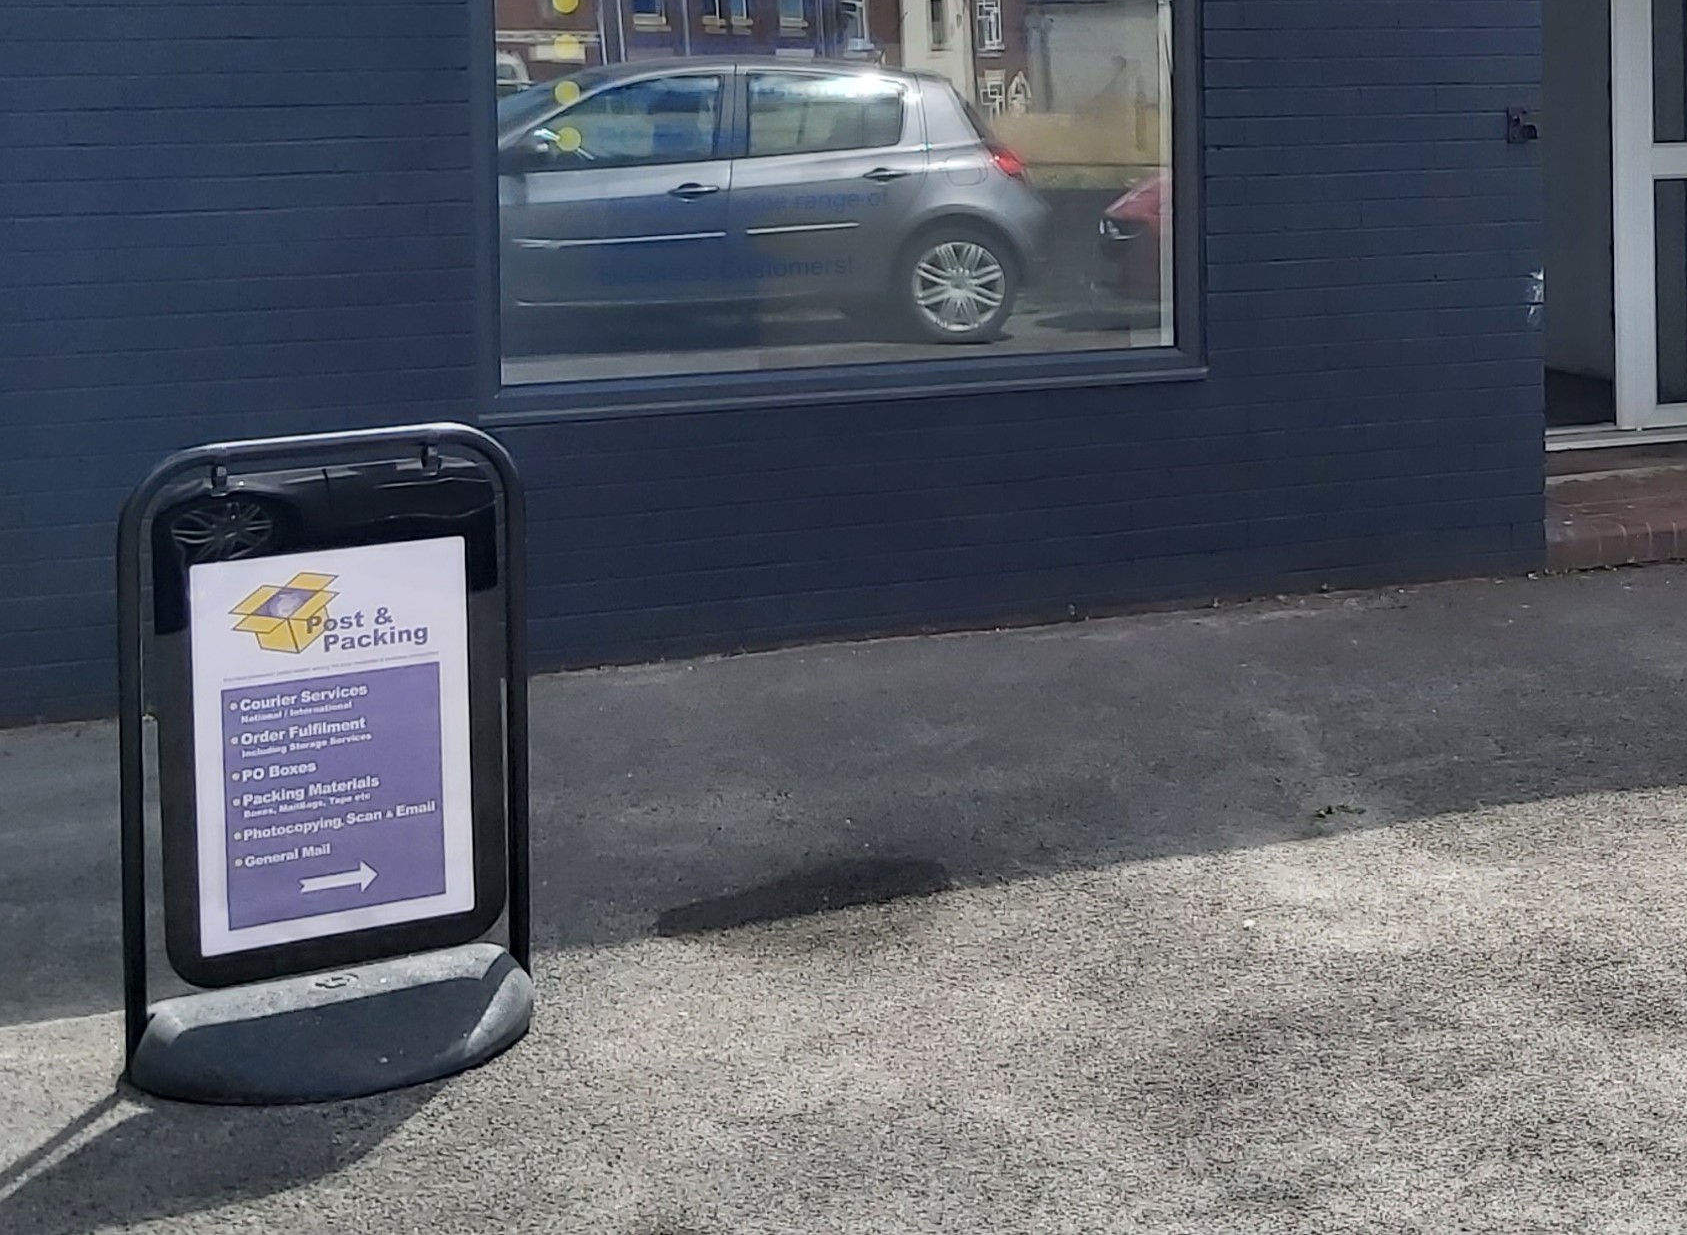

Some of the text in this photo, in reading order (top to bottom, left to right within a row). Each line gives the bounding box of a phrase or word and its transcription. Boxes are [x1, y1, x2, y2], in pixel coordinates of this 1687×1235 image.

[306, 606, 393, 635] Post &
[323, 626, 428, 653] Packing
[239, 684, 369, 712] Courier Services
[240, 716, 367, 746] Order Fulfilment
[241, 732, 373, 759] Including Storage Services
[241, 761, 318, 783] PO Boxes
[243, 775, 381, 807] Packing Materials
[345, 809, 383, 825] Scan
[395, 800, 436, 818] Email
[244, 842, 332, 868] General Mail
